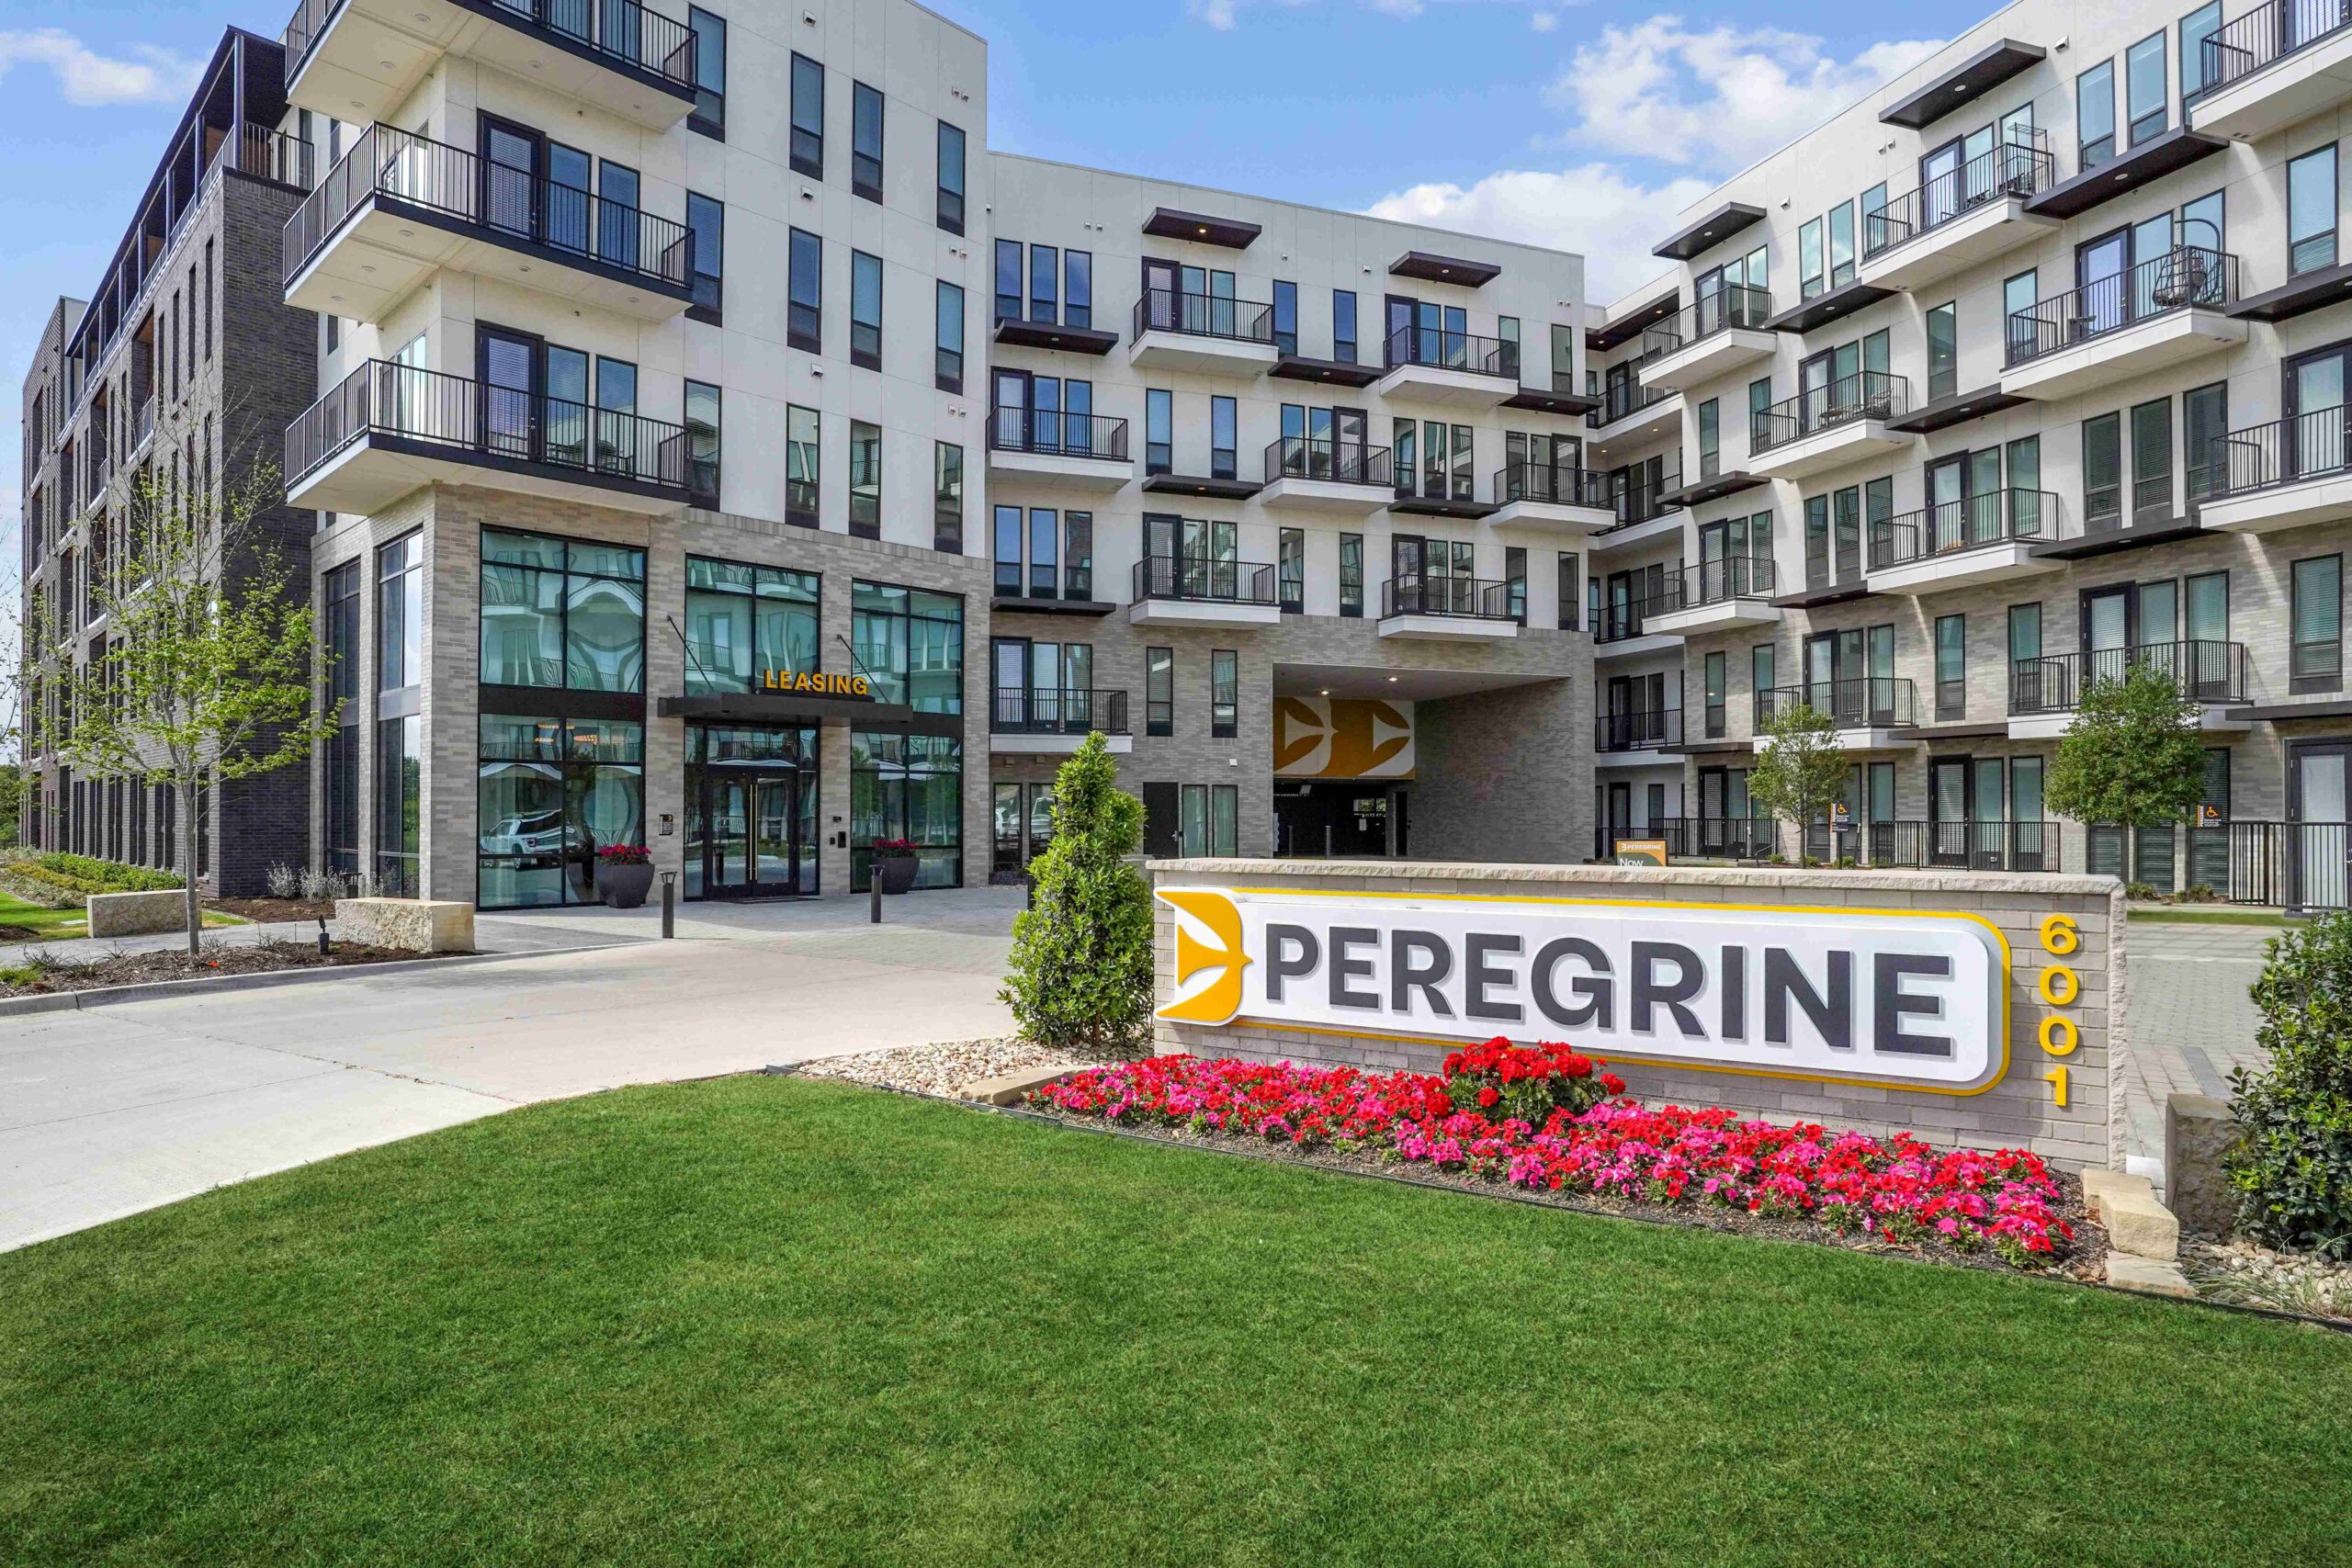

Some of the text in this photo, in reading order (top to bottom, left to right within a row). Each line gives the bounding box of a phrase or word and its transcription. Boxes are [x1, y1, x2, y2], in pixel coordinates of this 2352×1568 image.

[764, 669, 868, 695] LEASING
[1620, 858, 1644, 866] Now
[1266, 922, 1953, 1058] PEREGRINE
[2039, 914, 2078, 1107] 6001
